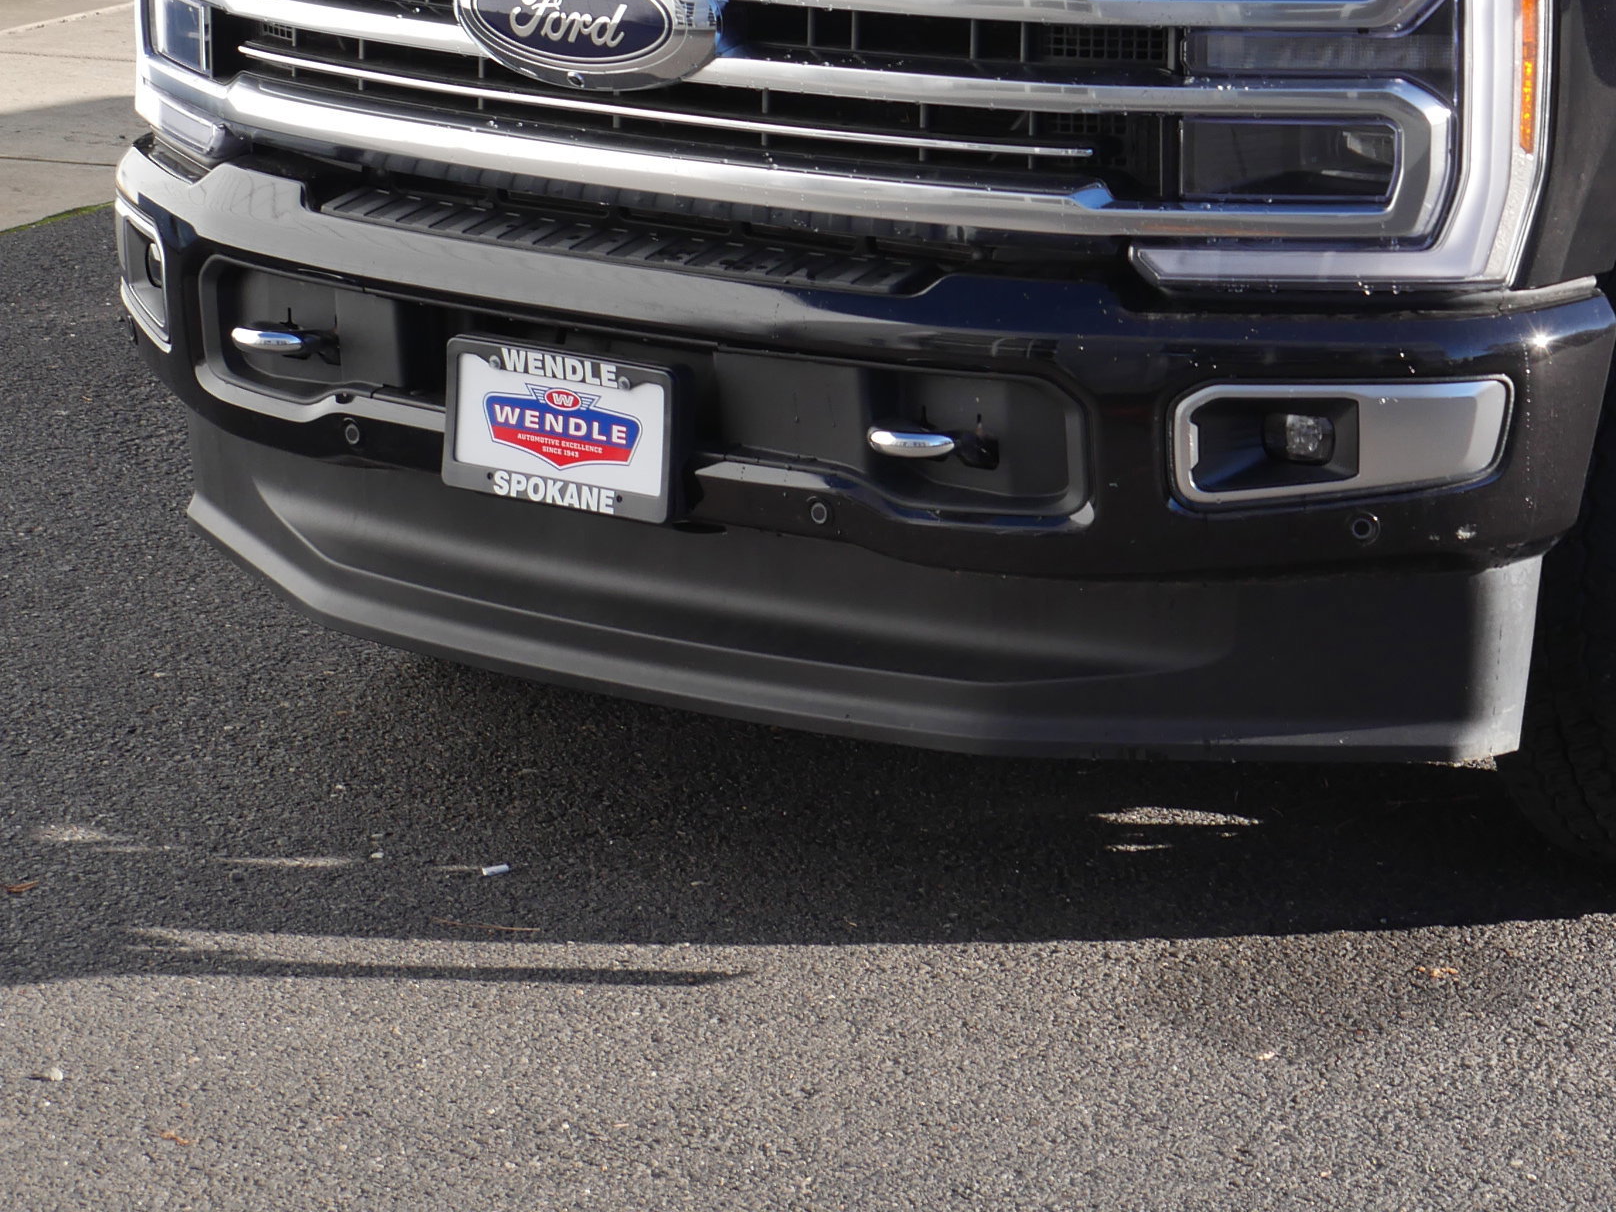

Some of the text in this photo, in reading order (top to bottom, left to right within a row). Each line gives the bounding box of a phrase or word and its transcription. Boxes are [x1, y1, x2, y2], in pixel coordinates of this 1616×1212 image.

[501, 347, 618, 389] WENDLE
[551, 392, 574, 408] W
[493, 404, 628, 445] WENDLE
[517, 433, 603, 454] AUTOMOTIVE EXCELLENCE
[542, 445, 562, 456] SINCE
[493, 470, 615, 515] SPOKANE
